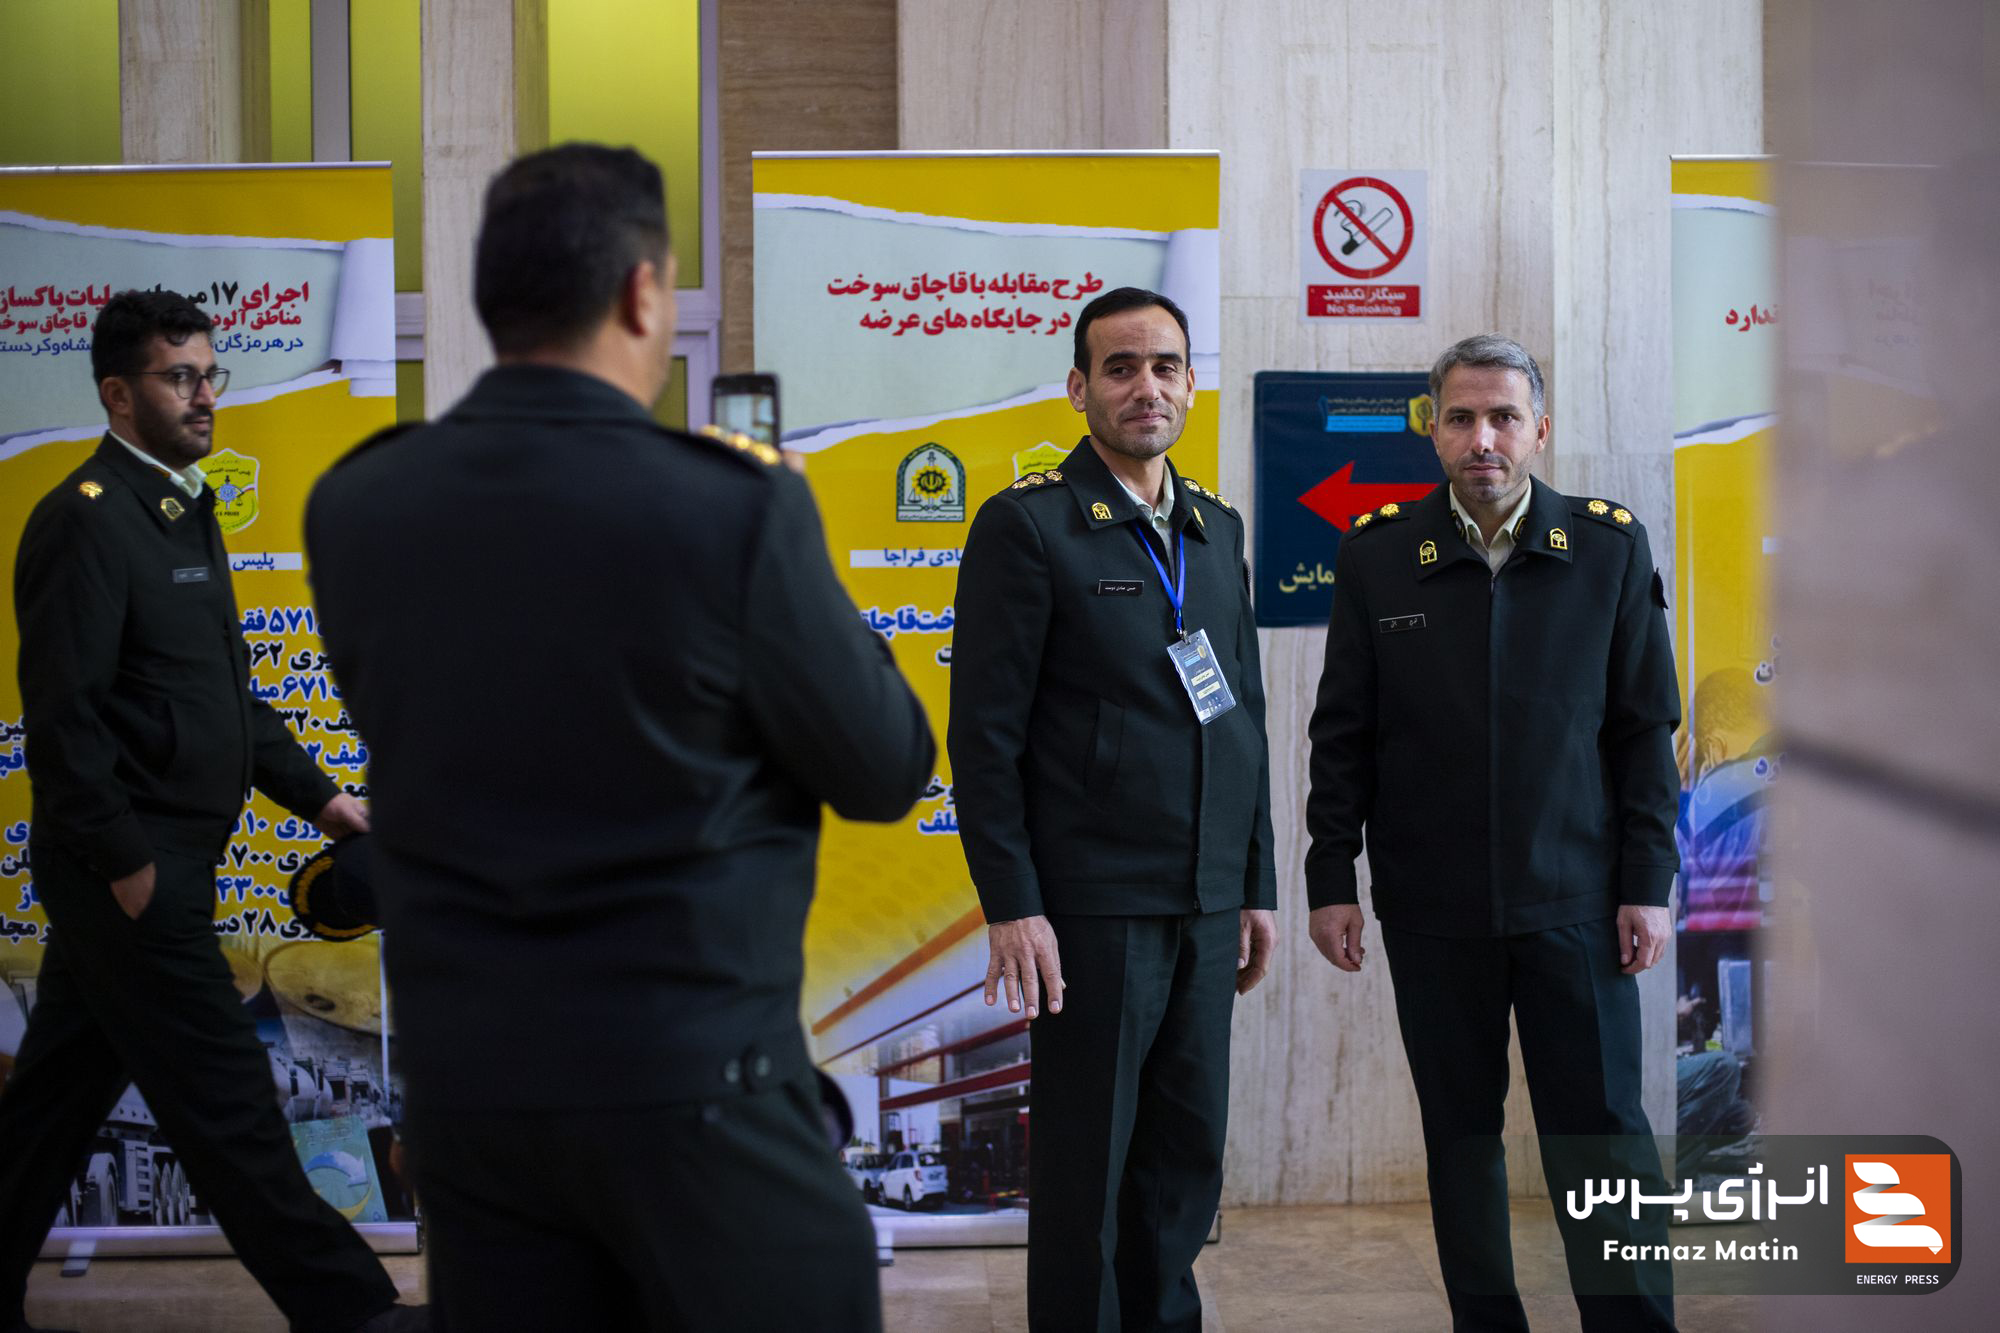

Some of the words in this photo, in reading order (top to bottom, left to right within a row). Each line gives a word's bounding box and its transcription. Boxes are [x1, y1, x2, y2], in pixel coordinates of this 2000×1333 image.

[65, 284, 110, 311] لیات
[211, 281, 239, 306] ۱۷
[241, 281, 309, 311] اجرای
[827, 273, 901, 301] سوخت
[902, 272, 967, 301] قاچاق
[969, 273, 986, 299] با
[988, 272, 1050, 299] مقابله
[1052, 272, 1105, 299] طرح
[1322, 287, 1365, 304] نکشید
[1368, 287, 1407, 304] سیگار
[0, 285, 64, 314] پاکساز
[1327, 304, 1345, 314] No
[1347, 304, 1402, 316] Smoking
[0, 313, 38, 335] سوخ
[40, 311, 88, 335] قاچاق
[211, 307, 247, 332] آلود
[250, 309, 302, 331] مناطق
[859, 309, 921, 337] عرضه
[922, 307, 968, 336] های
[971, 307, 1042, 335] جایگاه
[1045, 310, 1072, 336] در
[284, 337, 304, 352] در
[232, 551, 275, 572] پلیس
[883, 546, 926, 568] فراجا
[1278, 562, 1336, 593] مایش
[268, 606, 314, 634] ۵۷۱
[281, 675, 328, 701] ۶۷۱
[229, 842, 275, 869] ۷۰۰
[242, 908, 277, 935] ۲۸
